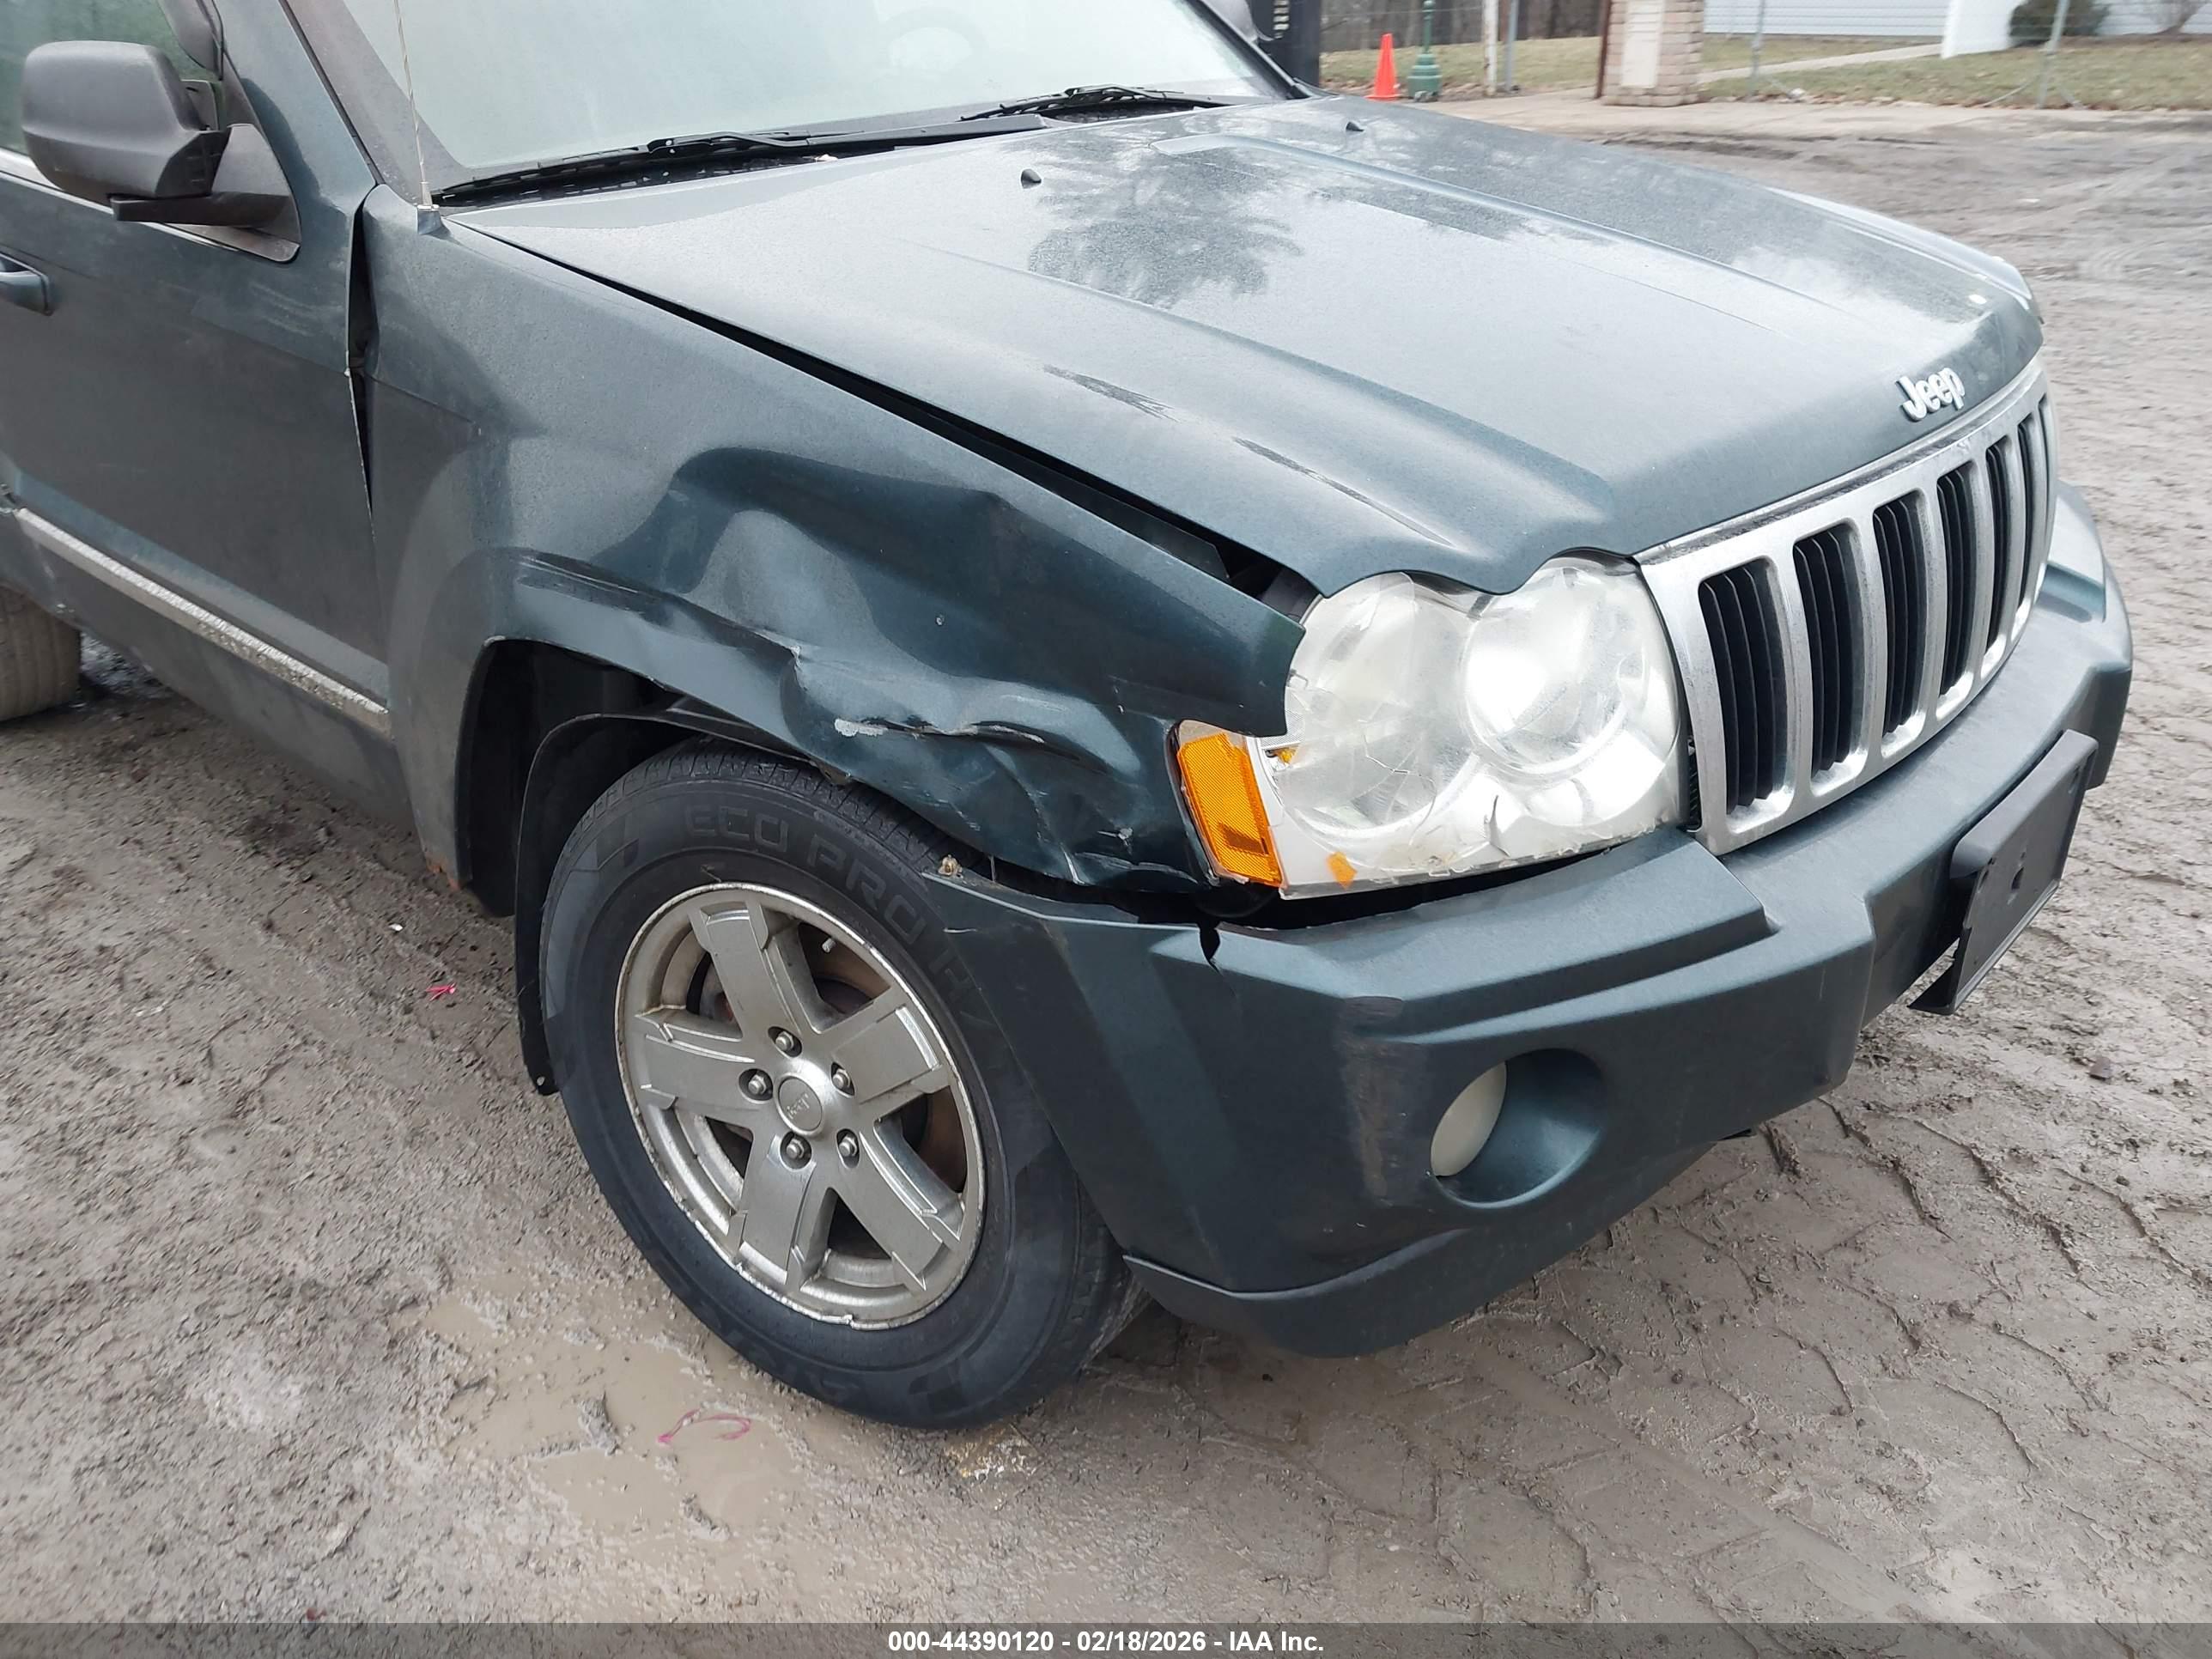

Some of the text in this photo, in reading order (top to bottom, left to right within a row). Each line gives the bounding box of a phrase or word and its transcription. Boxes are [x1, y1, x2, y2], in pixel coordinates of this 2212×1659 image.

[1894, 367, 1966, 422] Jeep
[685, 804, 789, 853] ECO
[807, 832, 928, 945] PRO
